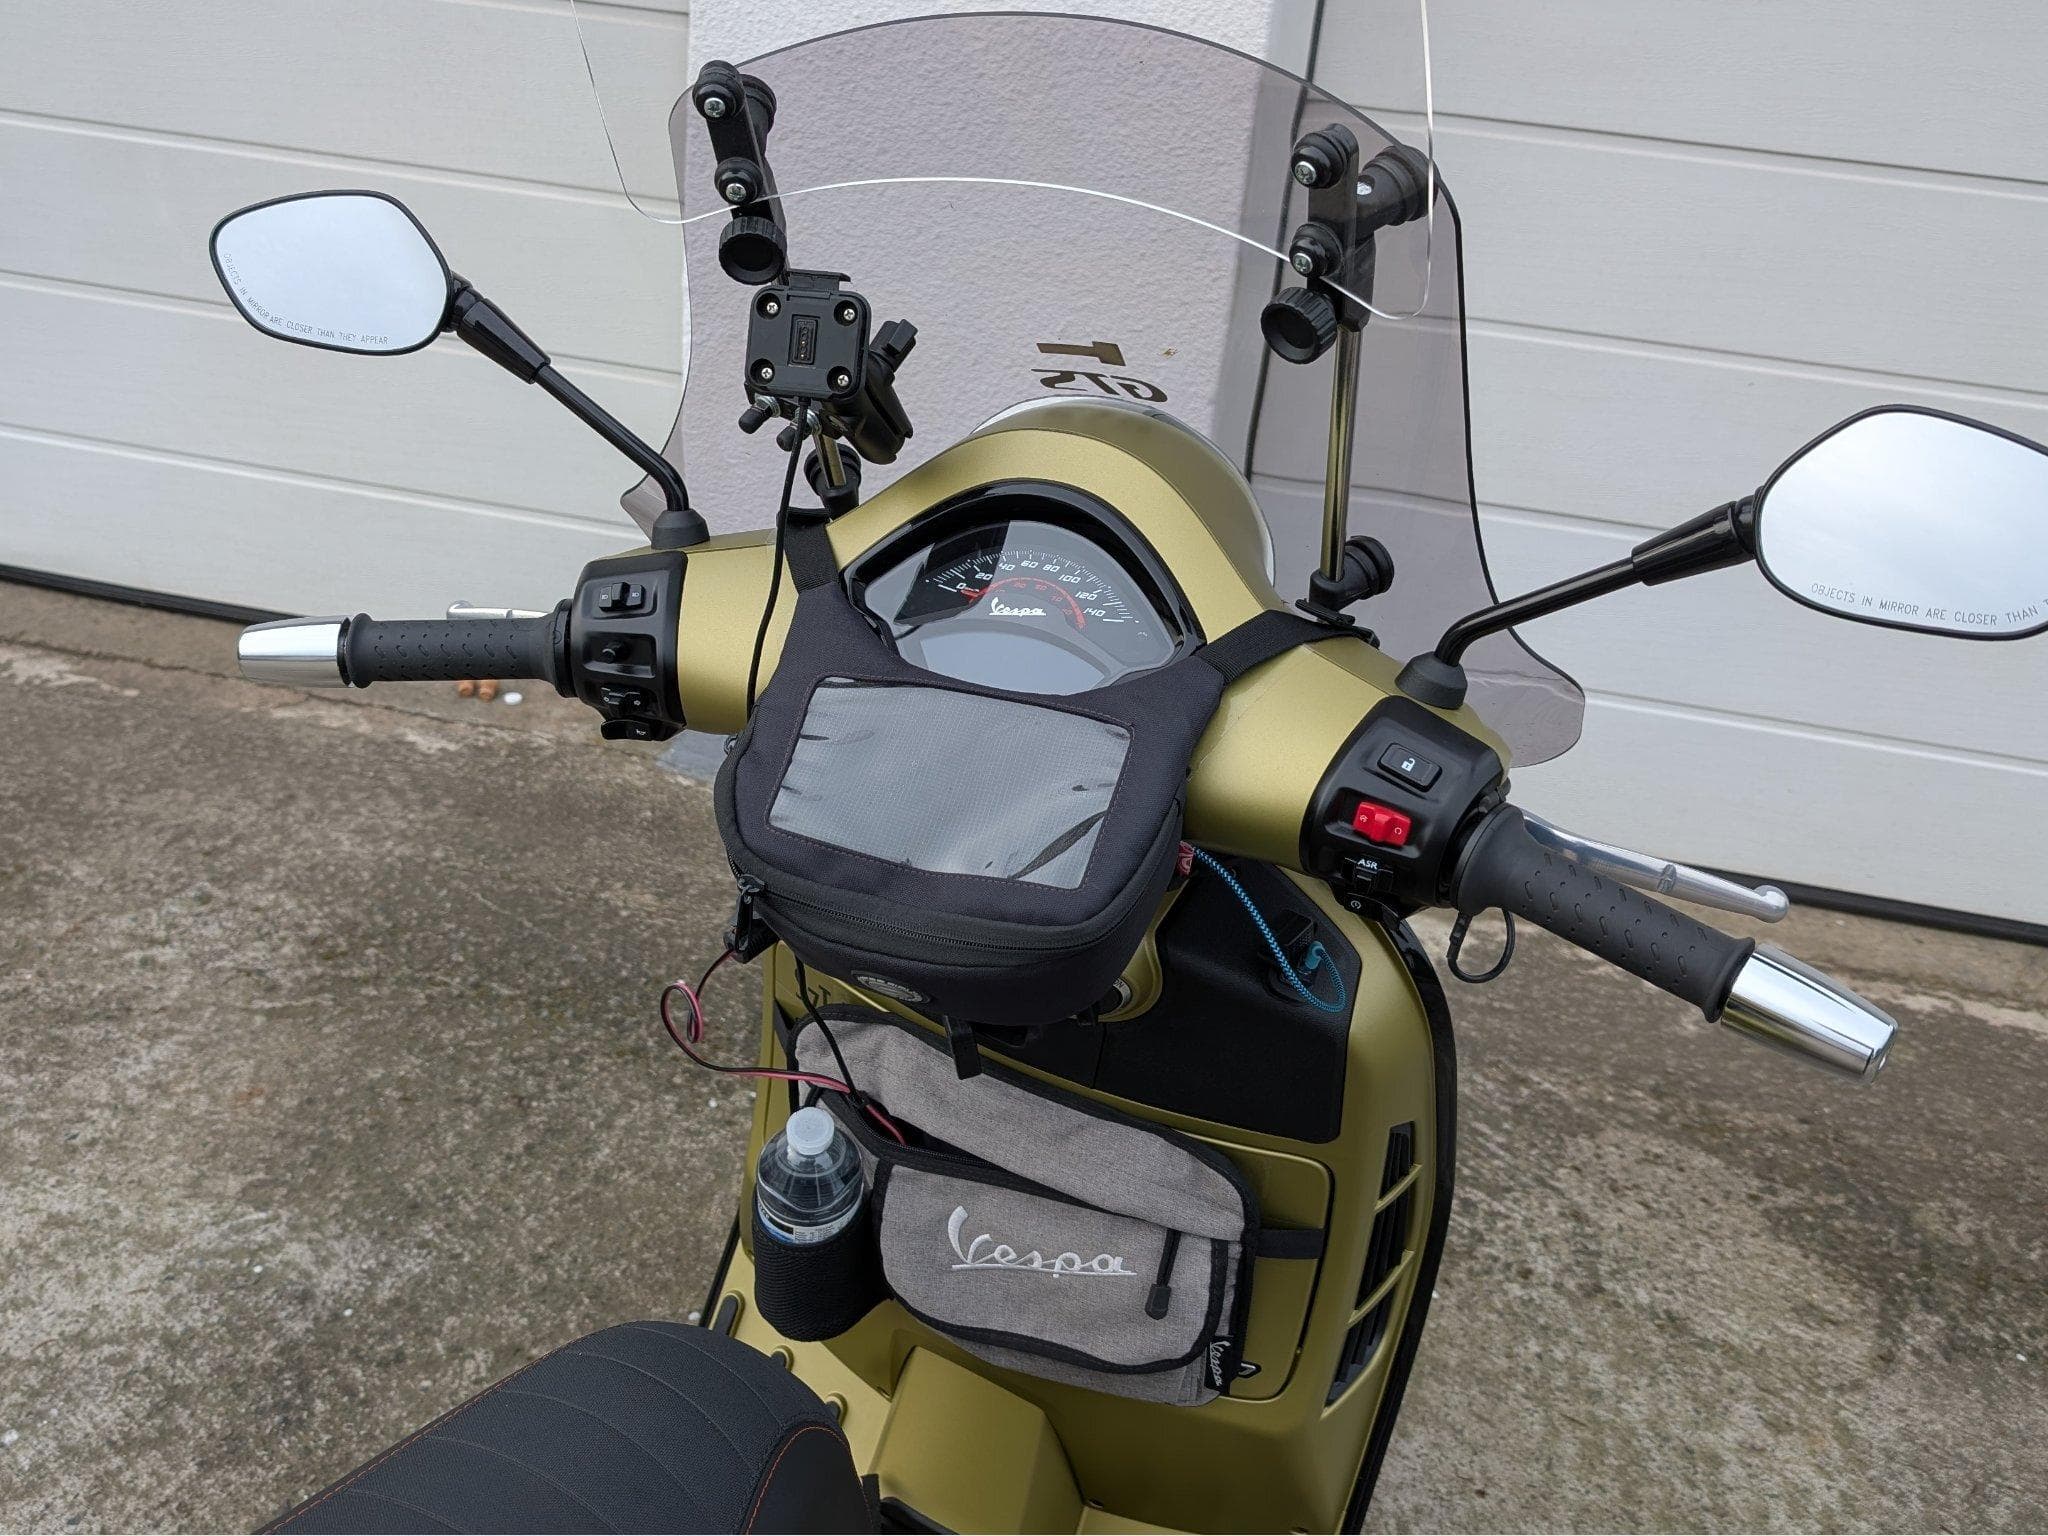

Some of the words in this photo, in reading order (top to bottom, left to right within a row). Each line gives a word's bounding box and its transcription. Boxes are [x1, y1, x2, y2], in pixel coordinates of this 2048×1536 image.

[247, 297, 270, 318] MIRROR
[269, 316, 283, 327] ARE
[286, 320, 313, 334] CLOSER
[317, 327, 335, 338] THAN
[339, 332, 356, 342] THEY
[360, 335, 389, 344] APPEAR
[999, 563, 1015, 571] 40
[1021, 560, 1039, 568] 60
[1043, 564, 1060, 572] 80
[975, 572, 993, 581] 20
[1059, 574, 1081, 584] 100
[1075, 591, 1098, 601] 120
[989, 597, 1047, 617] Vespa
[1810, 583, 1855, 604] OBJECTS
[1861, 596, 1873, 608] IN
[1879, 600, 1919, 616] MIRROR
[1925, 608, 1947, 621] ARE
[1953, 610, 1998, 626] CLOSER
[2004, 605, 2039, 624] THAN
[1083, 607, 1106, 617] 140
[1356, 858, 1378, 870] ASR
[946, 1205, 1138, 1278] Vespa
[1210, 1340, 1231, 1387] Vespa
